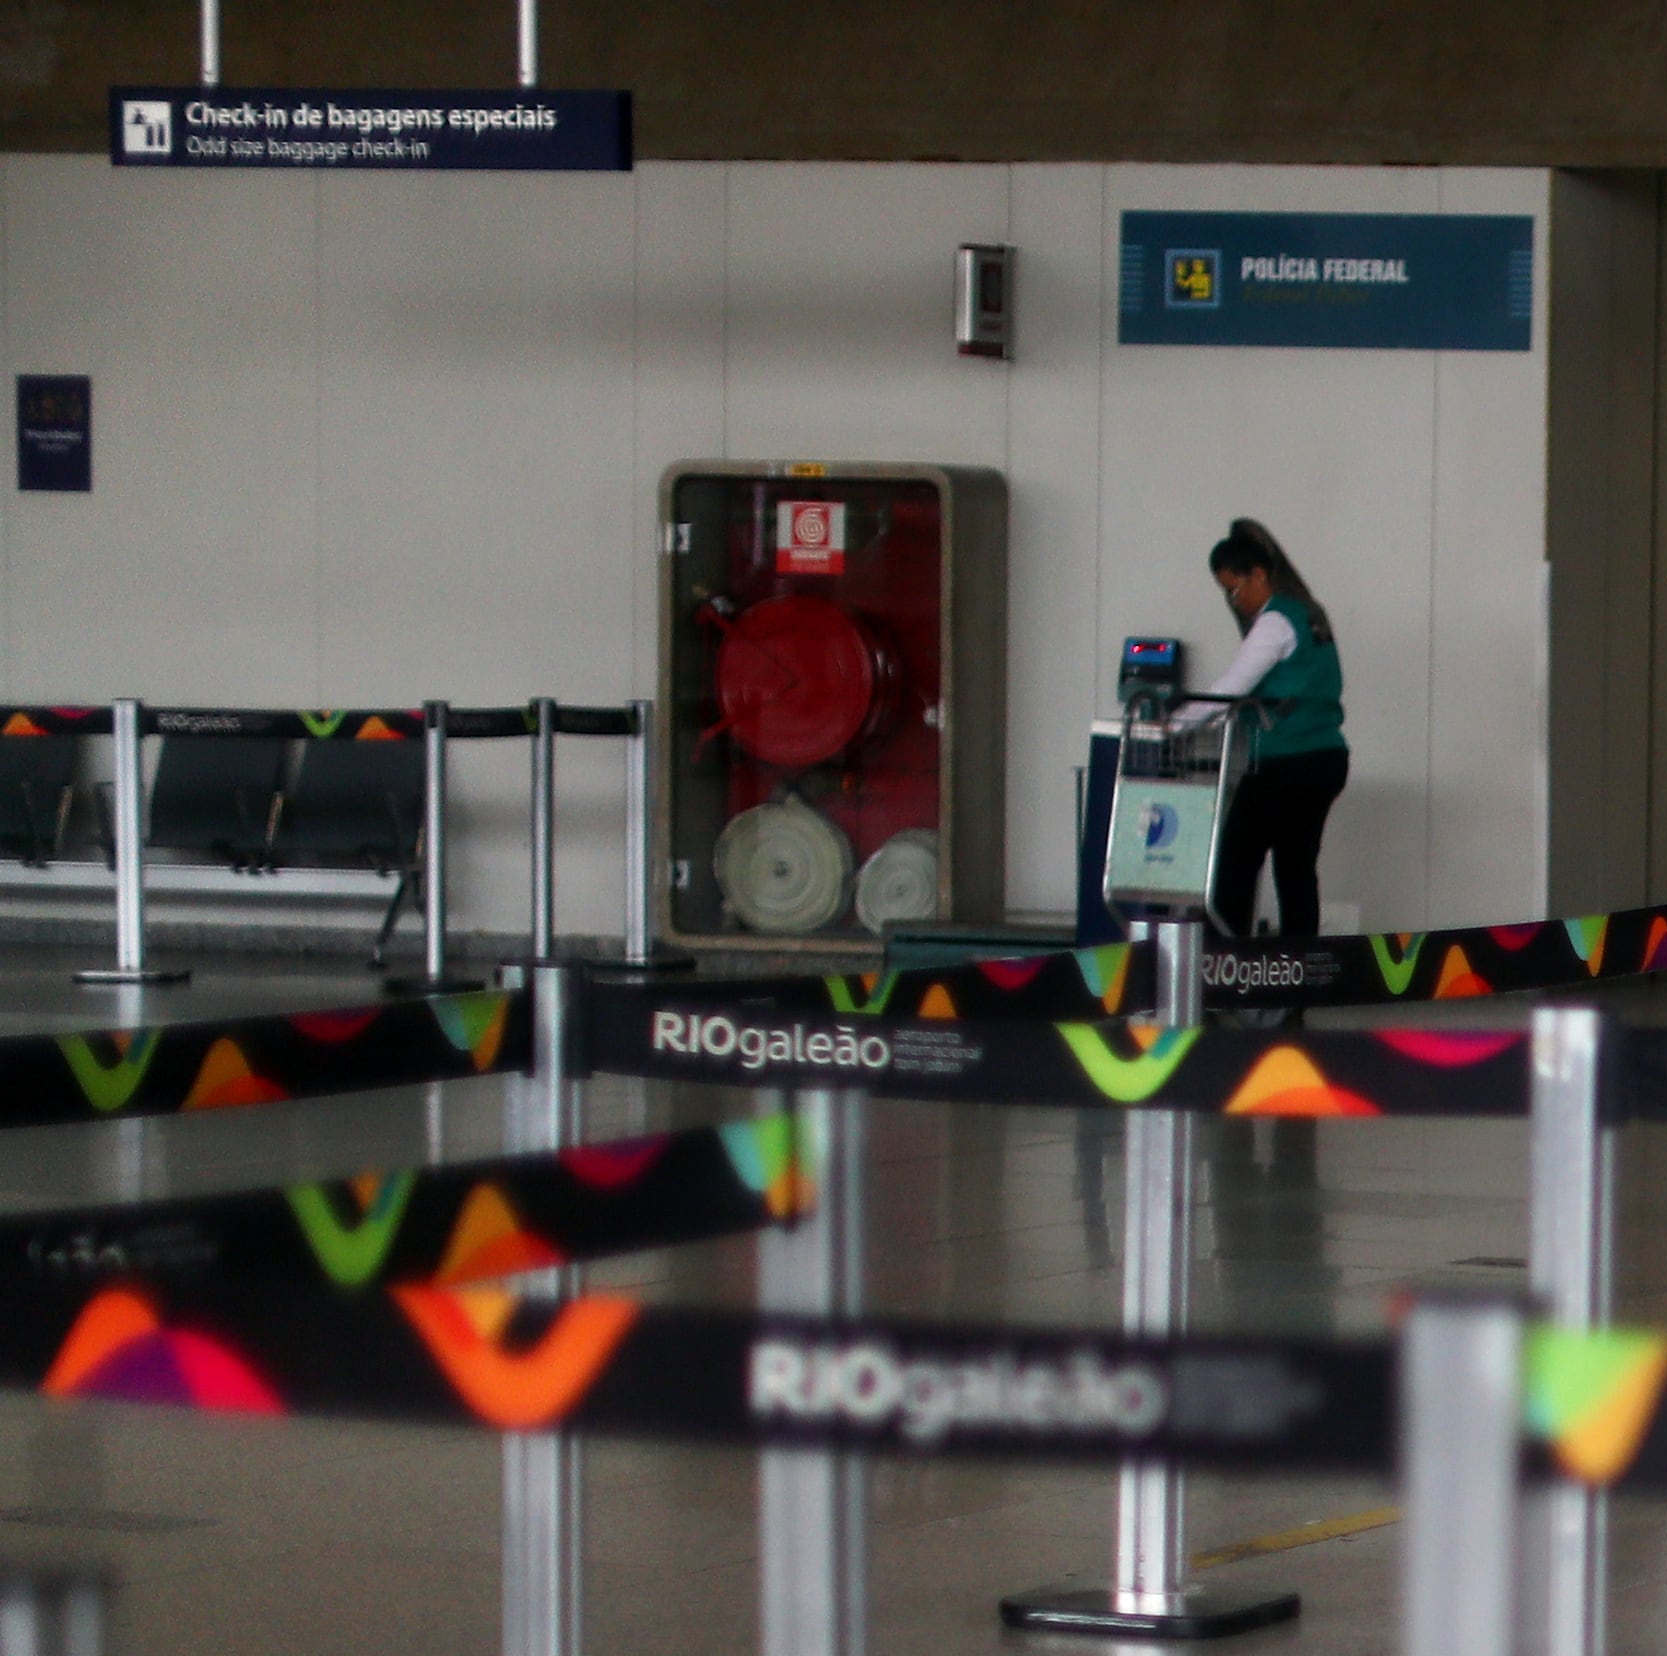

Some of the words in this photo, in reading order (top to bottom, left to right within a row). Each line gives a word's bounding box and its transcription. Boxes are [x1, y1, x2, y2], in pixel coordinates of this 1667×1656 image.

[185, 101, 288, 128] Check-in
[292, 103, 324, 128] de
[327, 103, 444, 134] bagagens
[447, 104, 558, 137] especiais
[187, 135, 228, 156] Odd
[231, 137, 264, 157] size
[267, 137, 348, 164] baggage
[350, 137, 429, 160] check-in
[1240, 252, 1319, 282] POLÍCIA
[1322, 258, 1409, 283] FEDERAL
[1200, 953, 1304, 994] RIOgaleão
[653, 1010, 890, 1069] RIOgaleão
